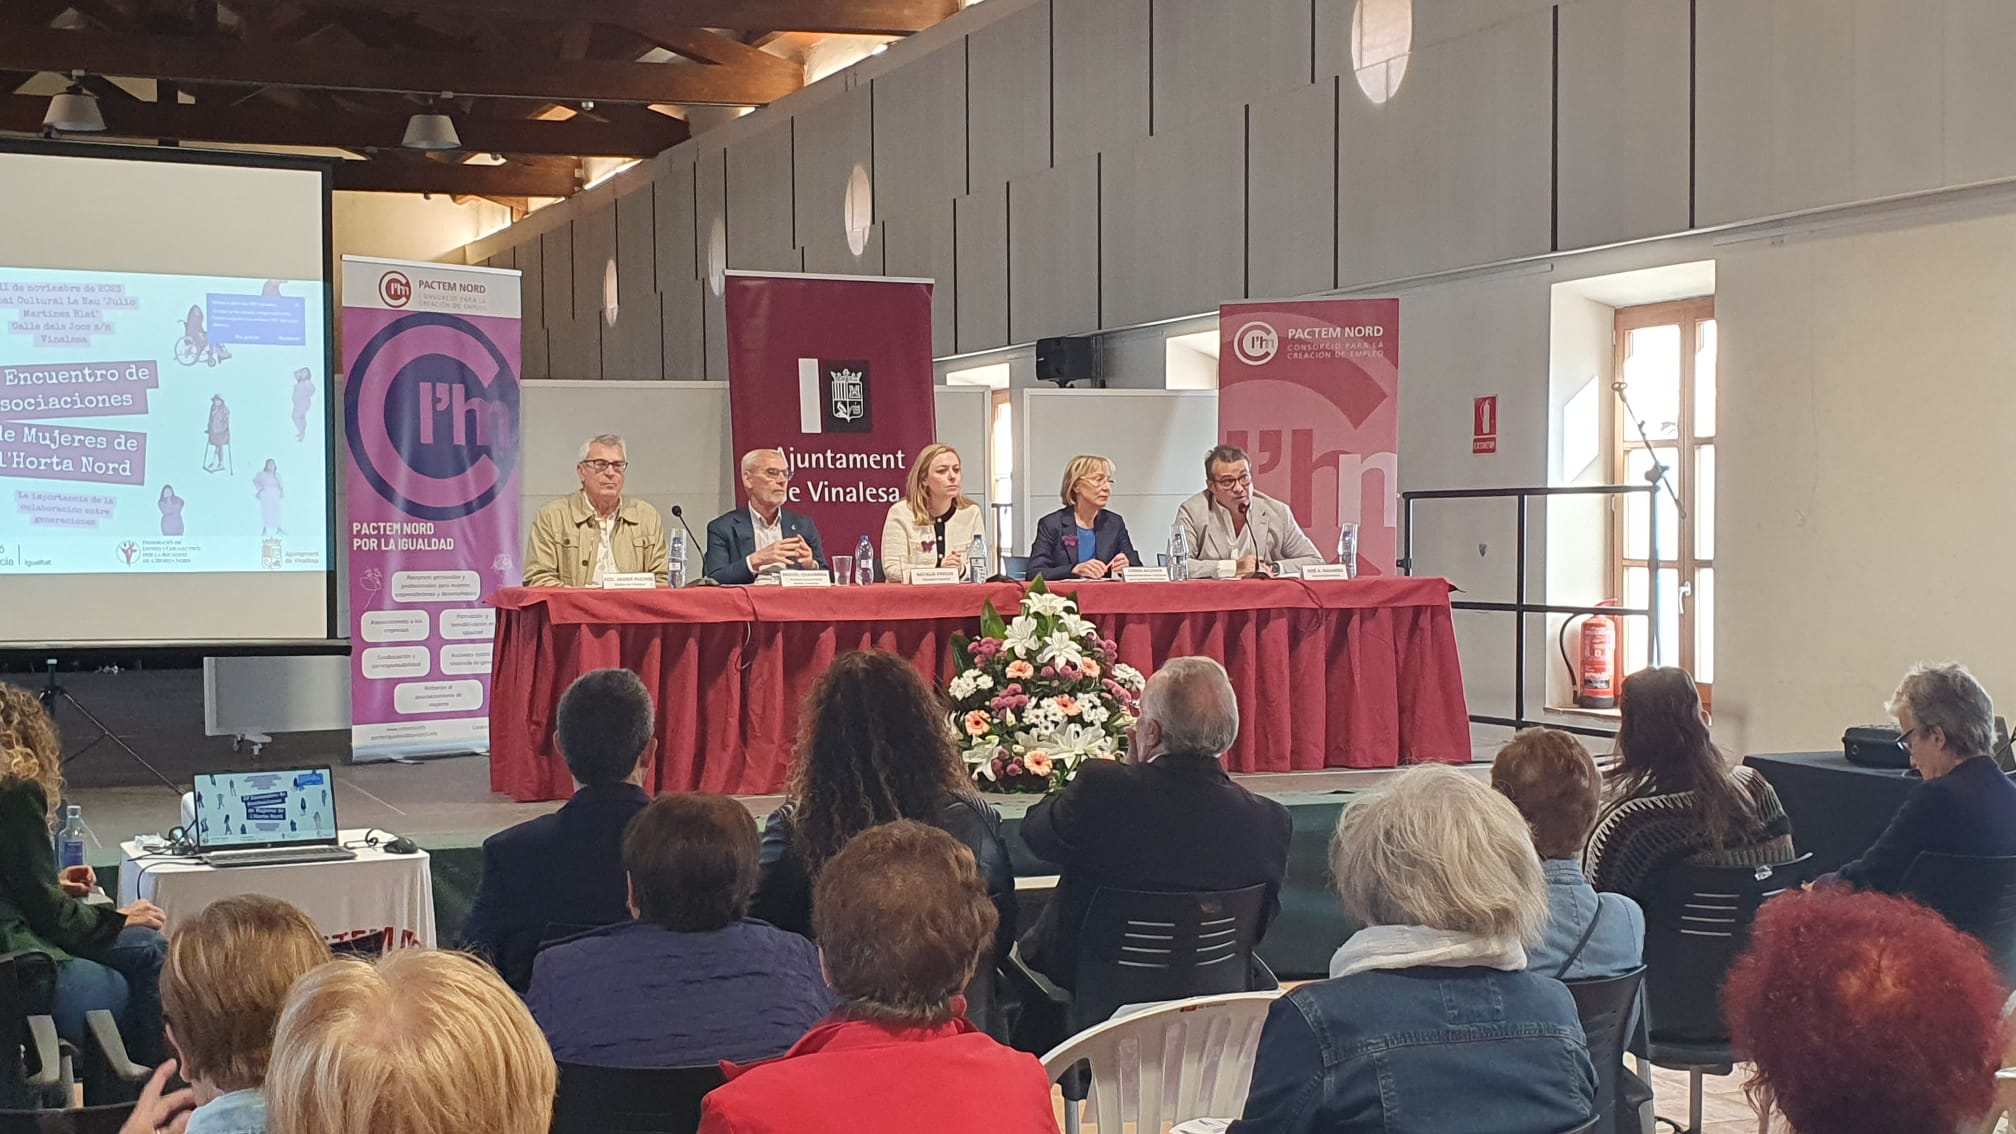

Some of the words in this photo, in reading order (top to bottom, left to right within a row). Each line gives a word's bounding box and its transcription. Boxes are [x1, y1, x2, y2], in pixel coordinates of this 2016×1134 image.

[418, 279, 457, 292] PACTEM
[459, 283, 487, 294] NORD
[1288, 326, 1341, 340] PACTEM
[1344, 326, 1384, 338] NORD
[1287, 342, 1341, 351] CONSORCIO
[1345, 342, 1369, 350] PARA
[1373, 341, 1384, 349] LA
[1335, 351, 1345, 359] DE
[1350, 350, 1384, 359] EMPLEO
[4, 366, 119, 385] Encuentro
[125, 364, 150, 381] de
[0, 392, 133, 411] sociaciones
[23, 426, 107, 449] Mujeres
[114, 434, 138, 451] de
[0, 451, 74, 471] l'Horta
[81, 456, 132, 476] Nord
[787, 484, 801, 502] e
[807, 480, 900, 503] Vinalesa
[352, 522, 401, 535] PACTEM
[403, 522, 434, 535] NORD
[353, 538, 378, 551] POR
[381, 538, 395, 551] LA
[398, 538, 454, 551] IGUALDAD
